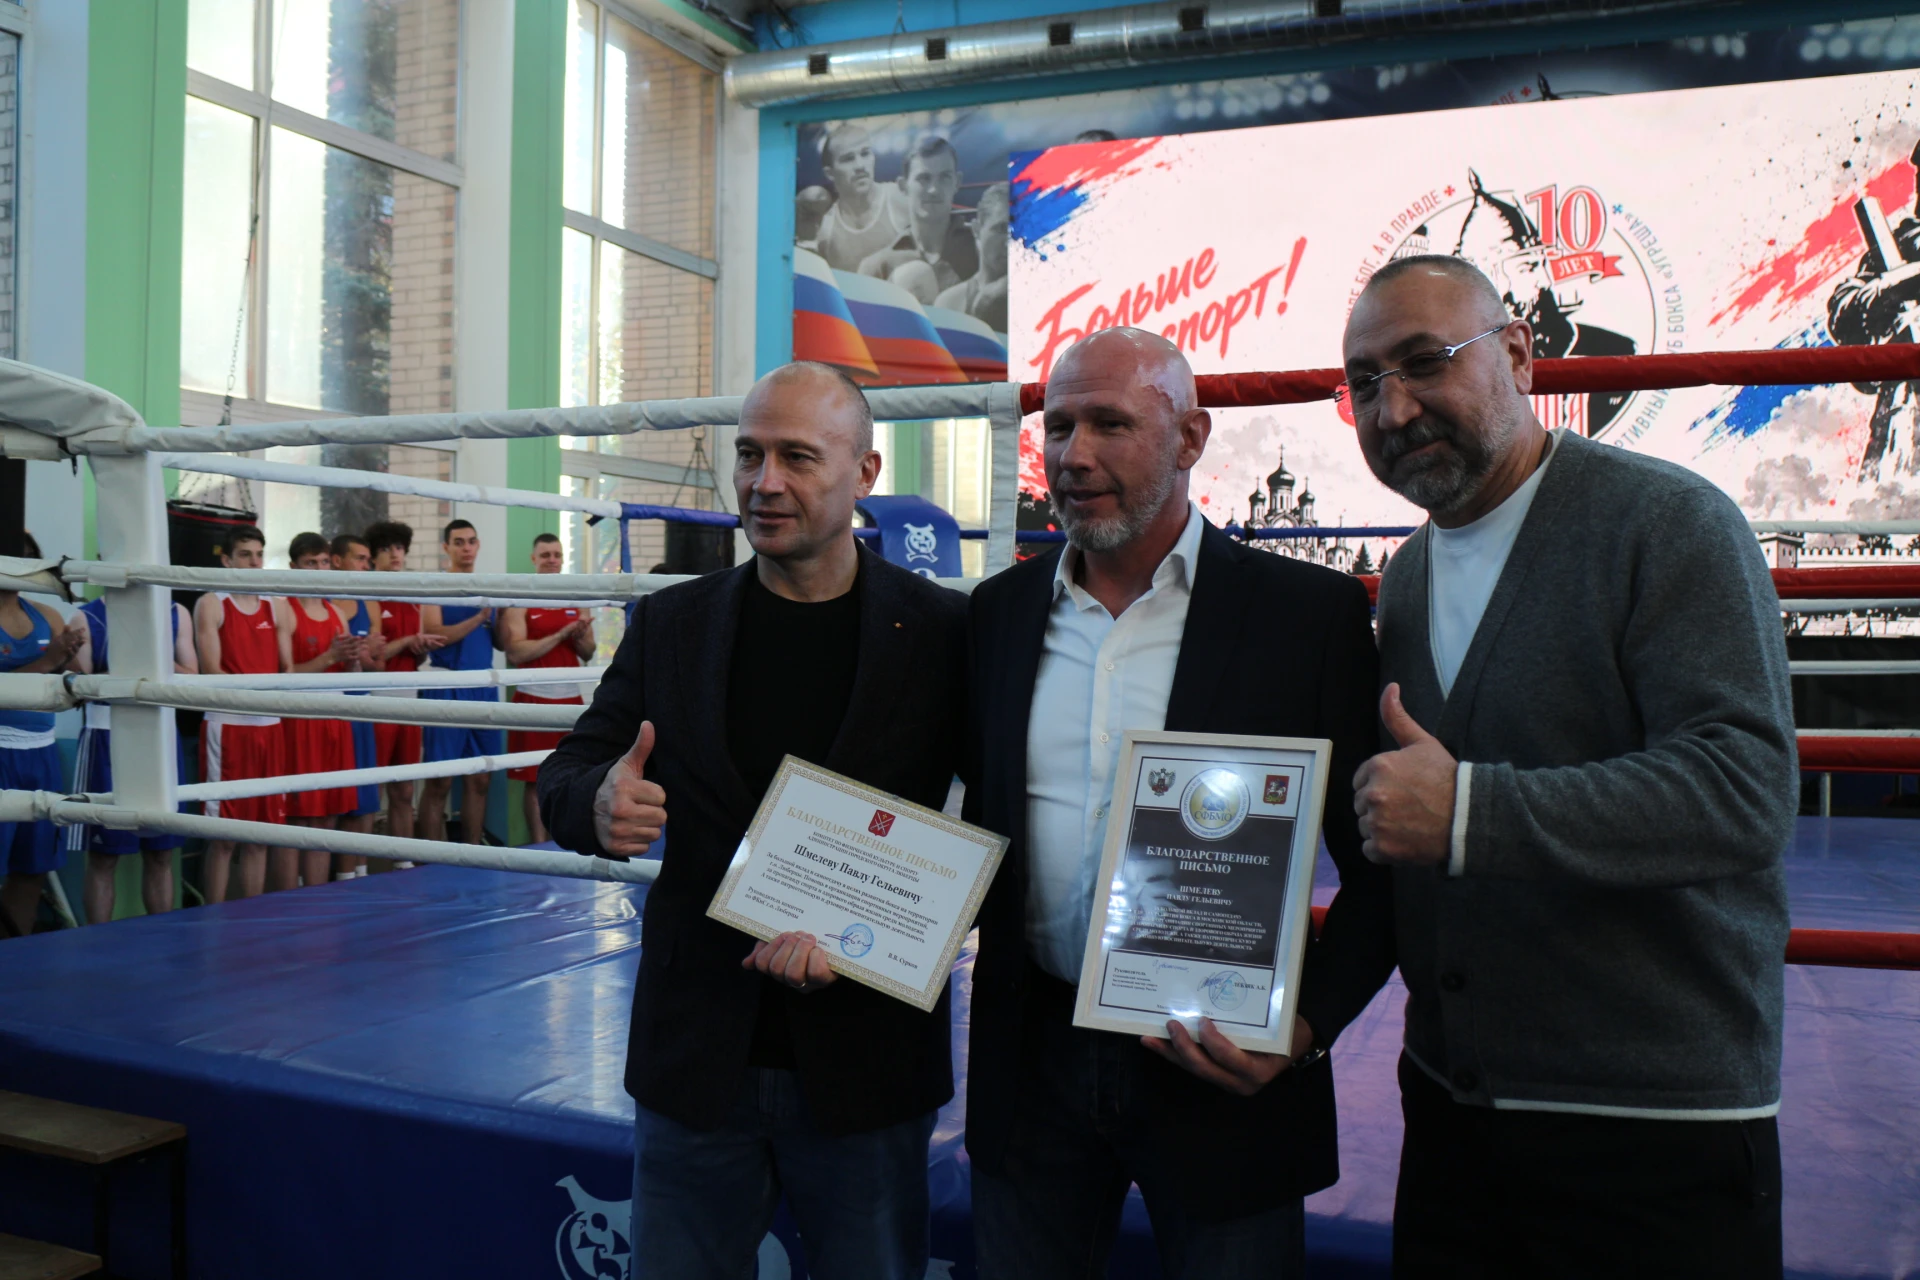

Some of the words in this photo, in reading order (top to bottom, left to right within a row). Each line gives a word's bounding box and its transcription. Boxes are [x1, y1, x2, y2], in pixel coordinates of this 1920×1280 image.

[1372, 244, 1387, 257] А
[1380, 231, 1395, 245] В
[1390, 189, 1442, 234] ПРАВДЕ
[1524, 183, 1608, 257] 10
[1624, 212, 1674, 279] «УГРЕША»
[1557, 255, 1596, 278] ЛЕТ
[1028, 247, 1219, 384] Больше
[1160, 236, 1308, 359] спорт!
[1664, 284, 1685, 333] БОКСА
[785, 805, 906, 861] БЛАГОДАРСТВЕННОЕ
[904, 852, 958, 882] ПИСЬМО
[1194, 810, 1232, 821] СФБМО
[791, 843, 840, 872] Шмелеву
[837, 861, 872, 884] Павлу
[868, 874, 924, 906] Гельевичу
[1145, 845, 1270, 866] БЛАГОДАРСТВЕННОЕ
[1179, 860, 1231, 874] ПИСЬМО
[772, 854, 796, 867] большой
[794, 863, 810, 873] вклад
[860, 890, 885, 904] развития
[884, 899, 900, 910] бокса
[906, 909, 938, 926] территории
[799, 881, 818, 892] спорта
[1166, 893, 1190, 901] ПАВЛУ
[1191, 896, 1233, 905] ГЕЛЬЕВИЧУ
[1179, 885, 1222, 896] ШМЕЛЕВУ
